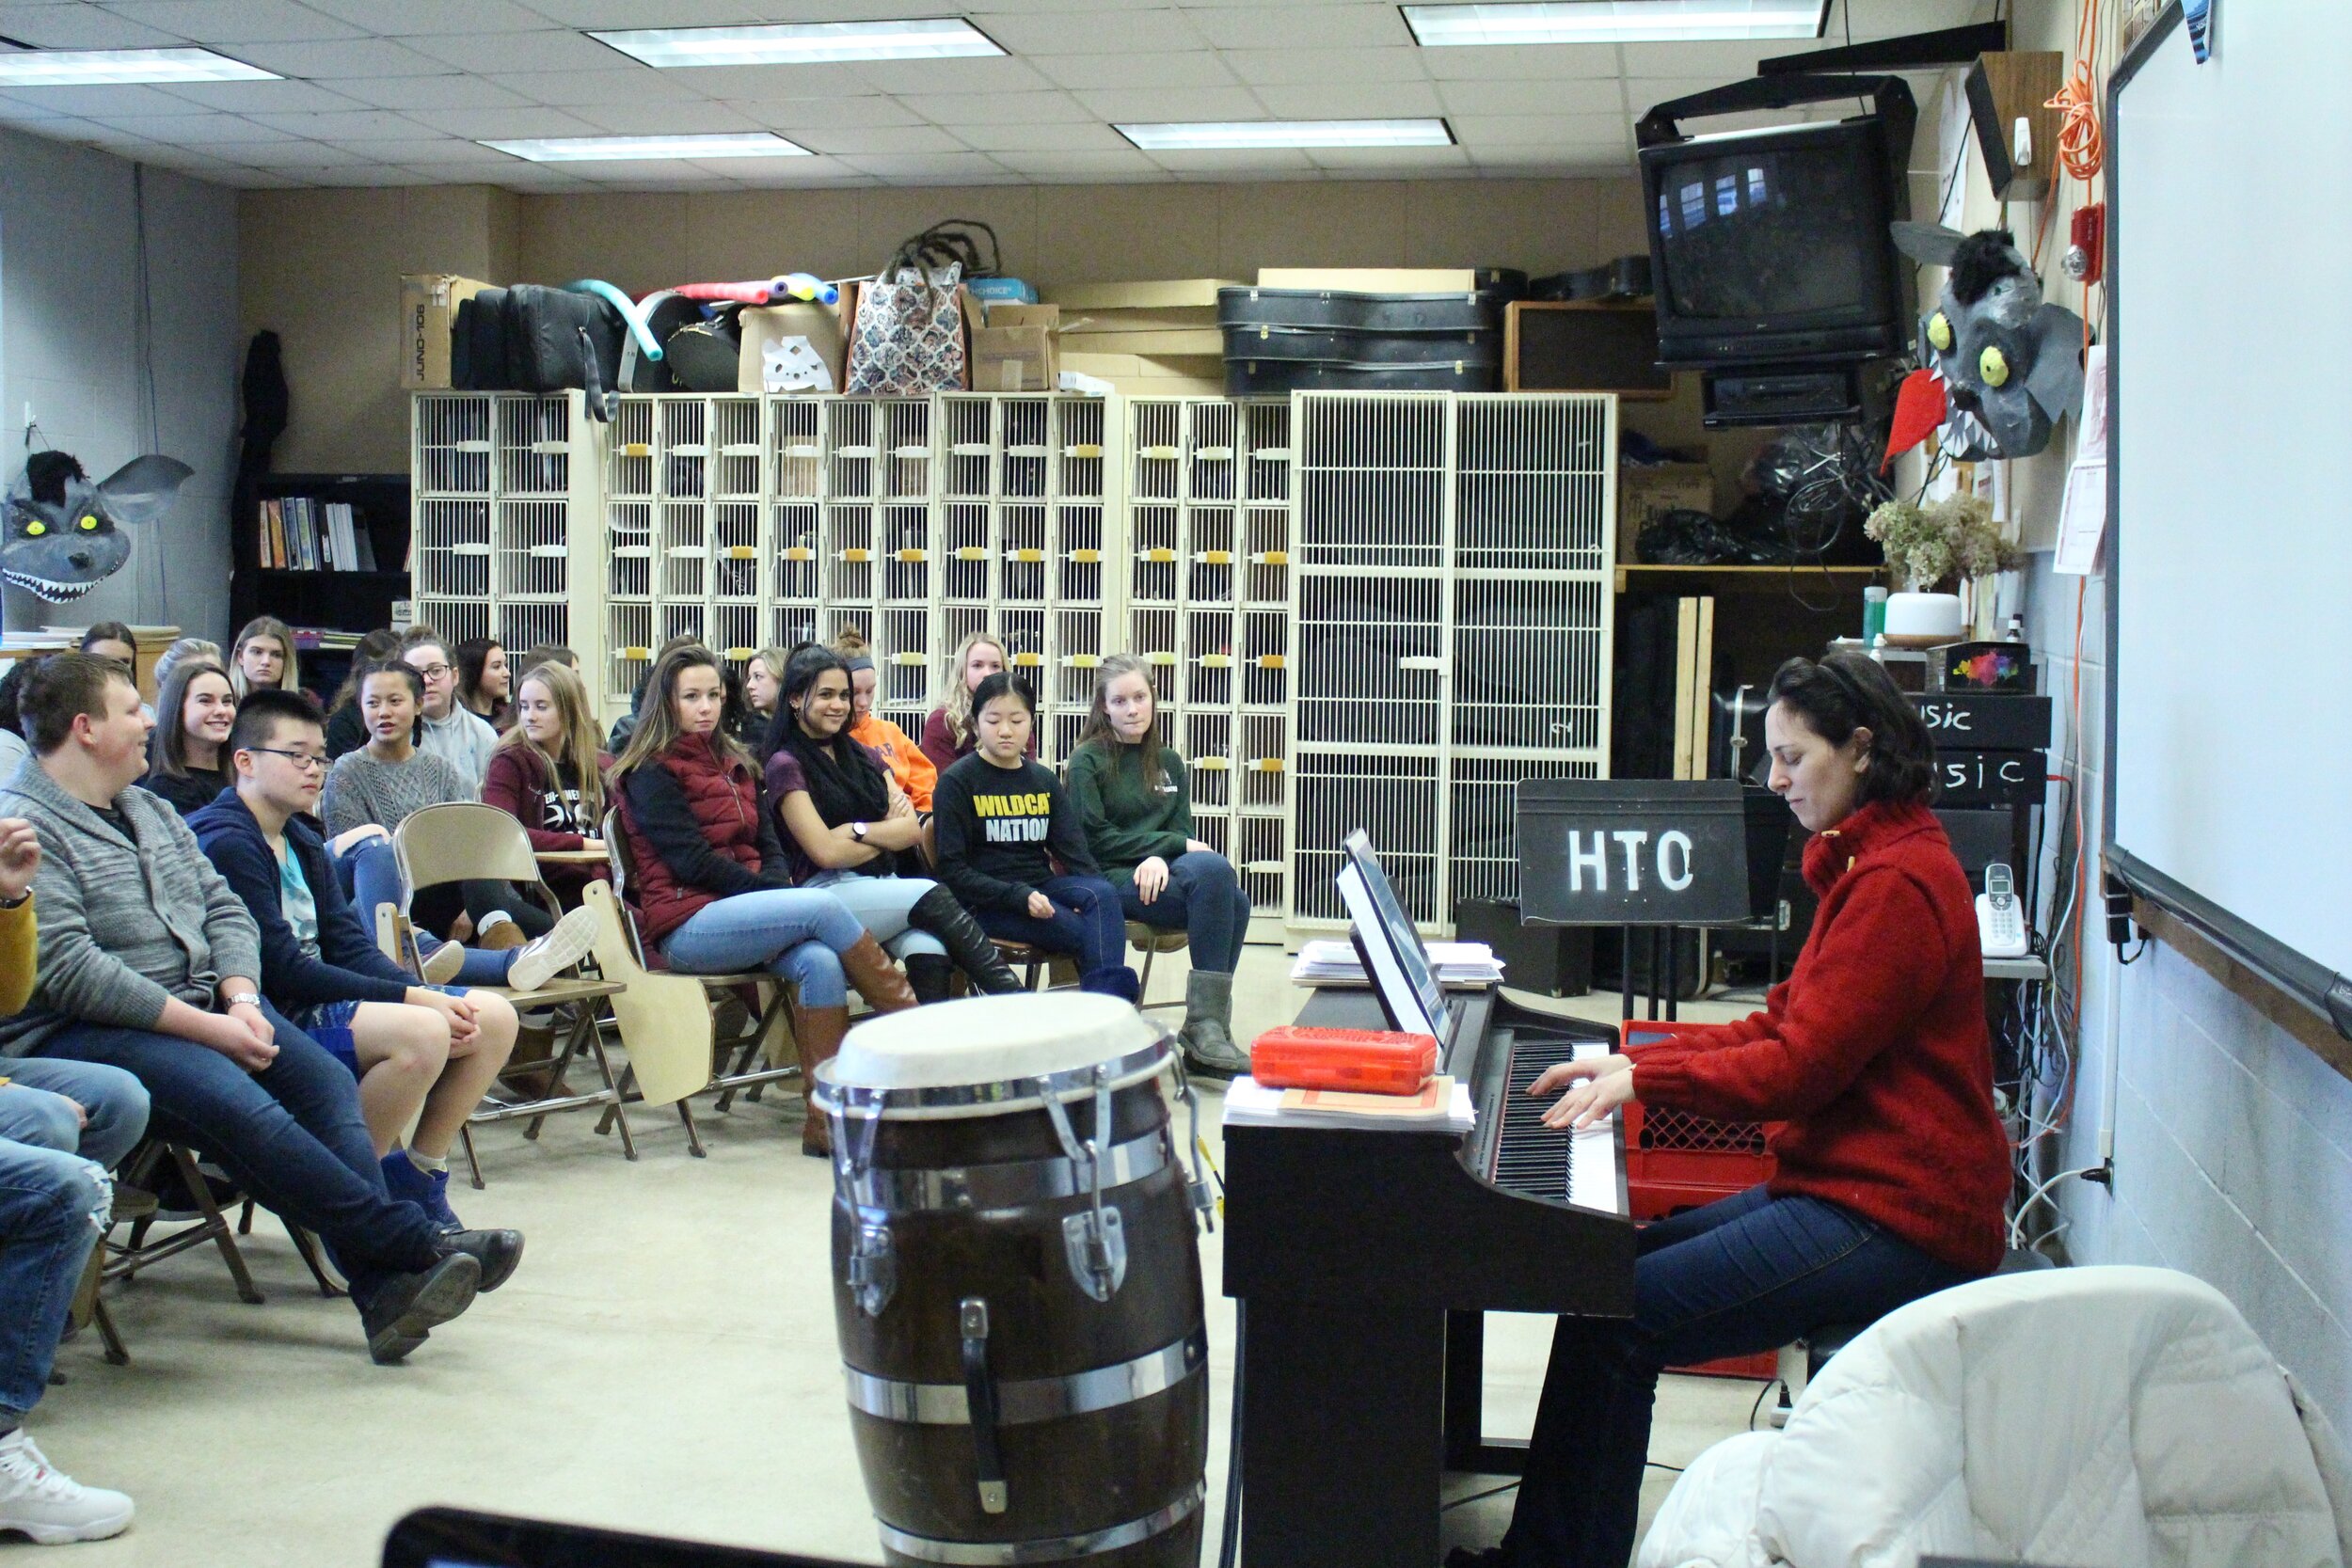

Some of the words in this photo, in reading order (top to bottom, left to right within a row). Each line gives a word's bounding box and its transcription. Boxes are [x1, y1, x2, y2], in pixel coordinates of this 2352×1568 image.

[416, 303, 425, 381] JUNO-106
[1920, 703, 1972, 731] sic
[1933, 755, 2025, 789] sic
[973, 792, 1051, 817] WILDCA
[985, 817, 1050, 842] NATION
